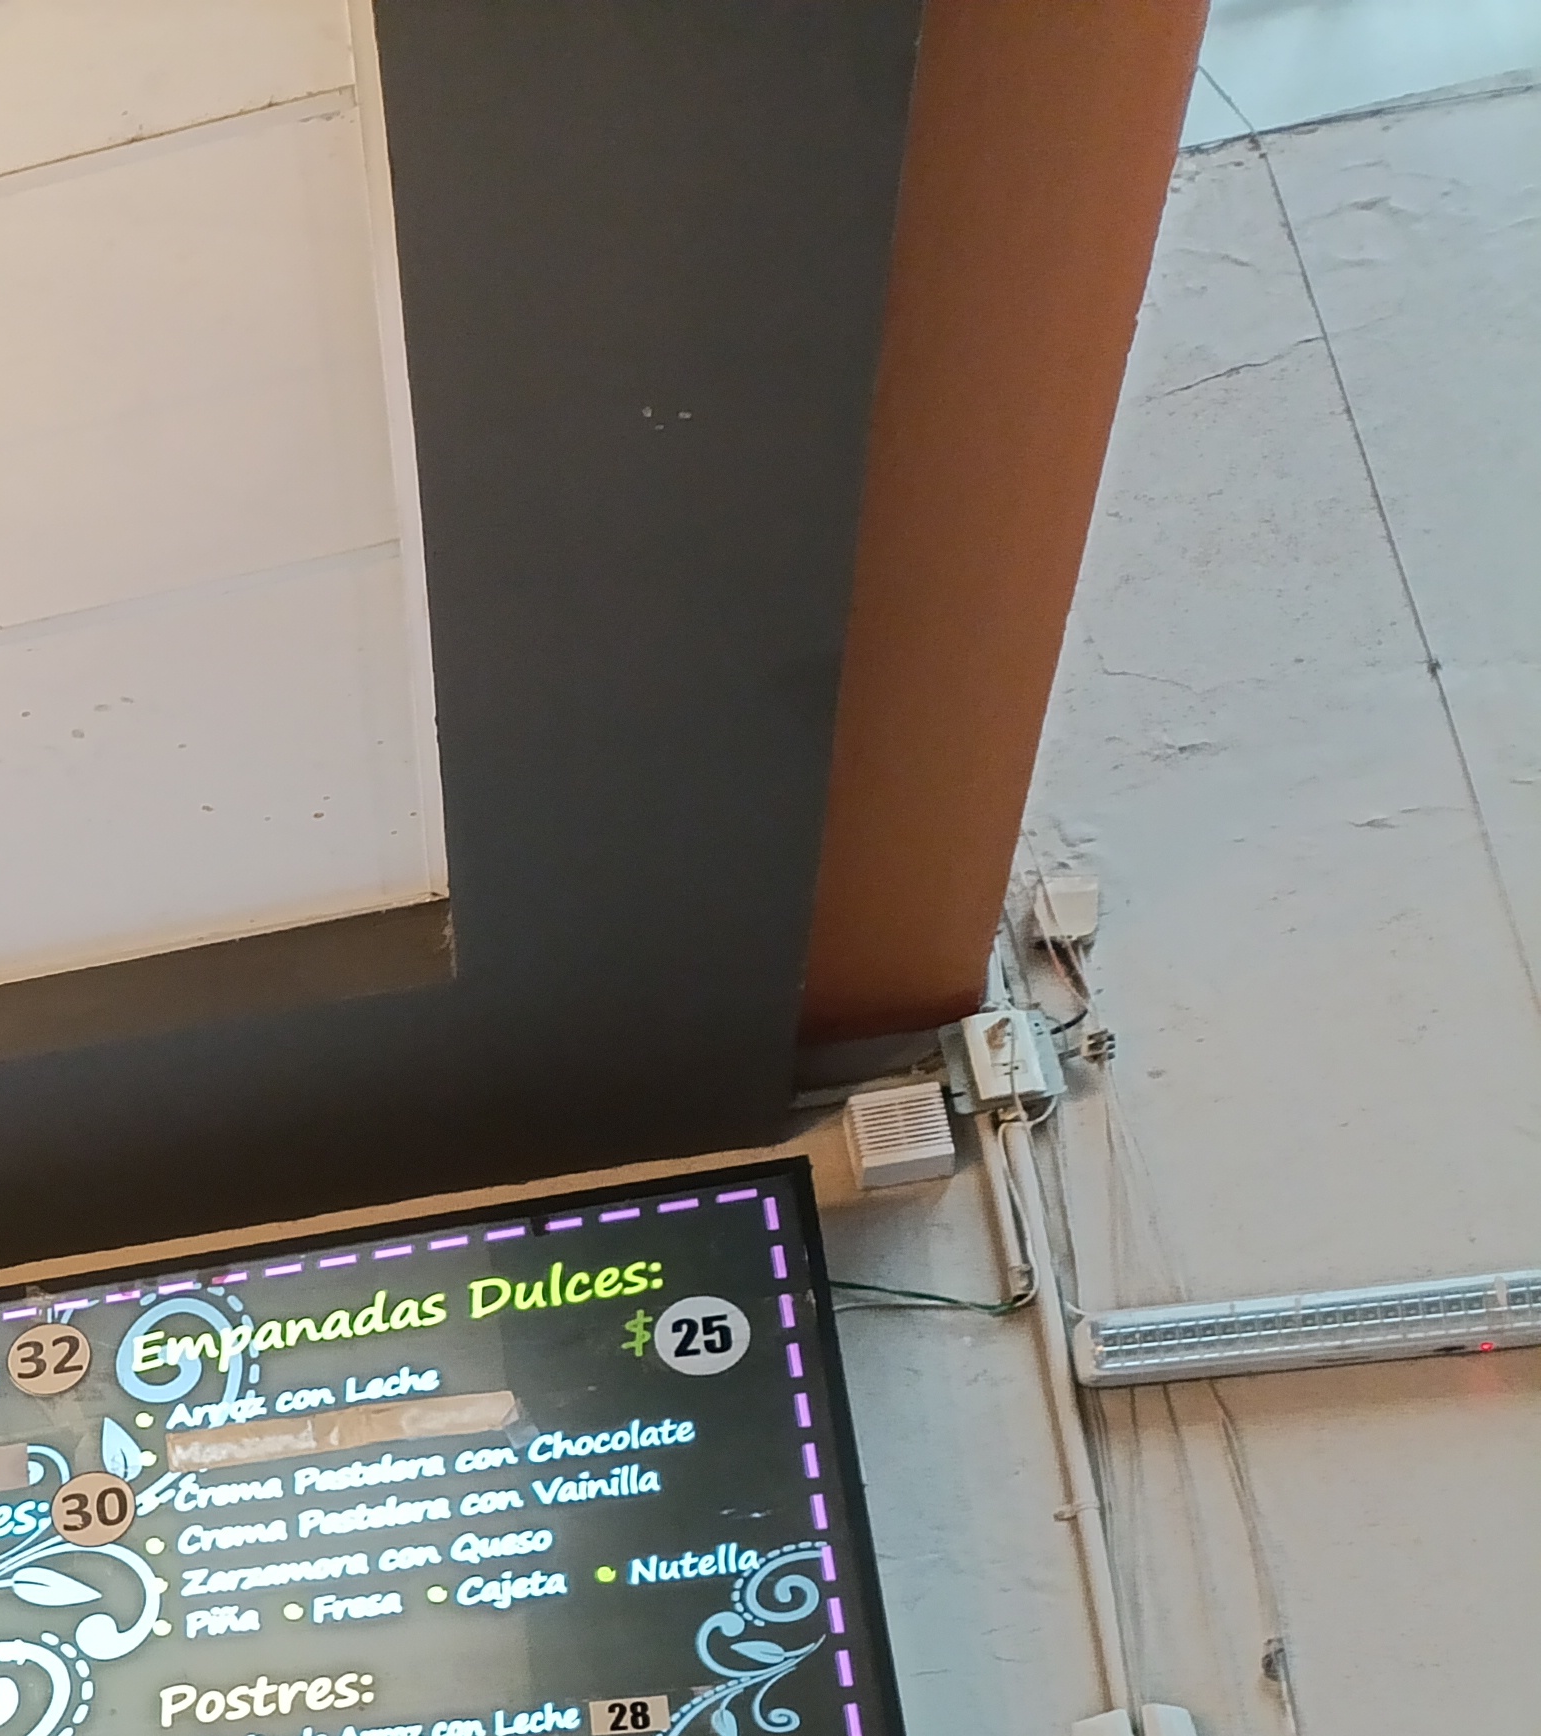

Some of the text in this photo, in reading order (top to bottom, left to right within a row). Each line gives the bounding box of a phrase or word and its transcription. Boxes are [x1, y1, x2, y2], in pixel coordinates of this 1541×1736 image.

[131, 1260, 664, 1373] Empanadas Dulces:
[670, 1314, 734, 1356] 25
[14, 1335, 82, 1380] 32
[274, 1380, 336, 1414] con
[344, 1365, 439, 1400] Leche
[173, 1418, 695, 1512] Crema Pastelera con Chocolate
[59, 1487, 127, 1531] 30
[185, 1543, 760, 1639] Piña Fresa Cajeta Nutella
[159, 1671, 376, 1728] Postres:
[495, 1702, 582, 1736] Leche
[608, 1701, 651, 1731] 28
